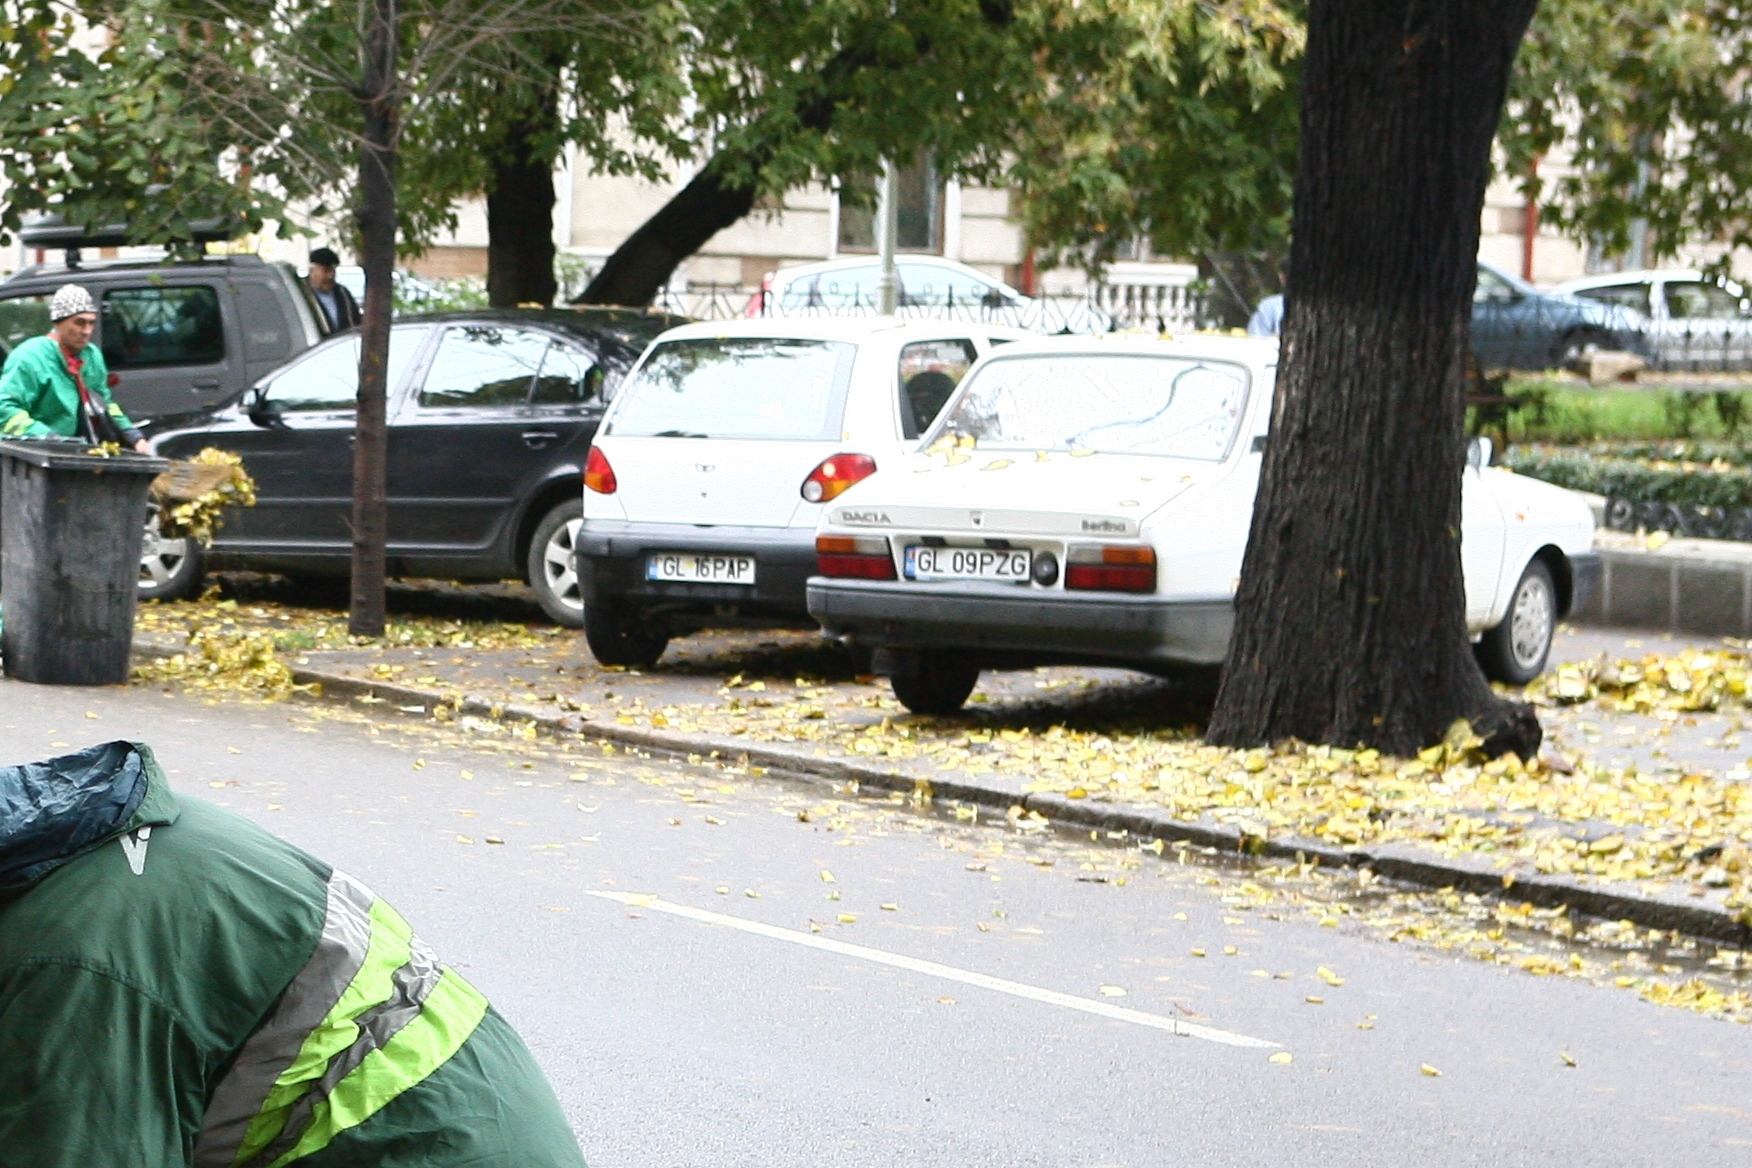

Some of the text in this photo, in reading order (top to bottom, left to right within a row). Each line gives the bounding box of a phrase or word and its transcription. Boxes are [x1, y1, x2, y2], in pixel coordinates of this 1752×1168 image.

[842, 511, 891, 524] DACIA
[662, 556, 750, 579] GL 16PAP
[917, 550, 1027, 576] GL 09PZG
